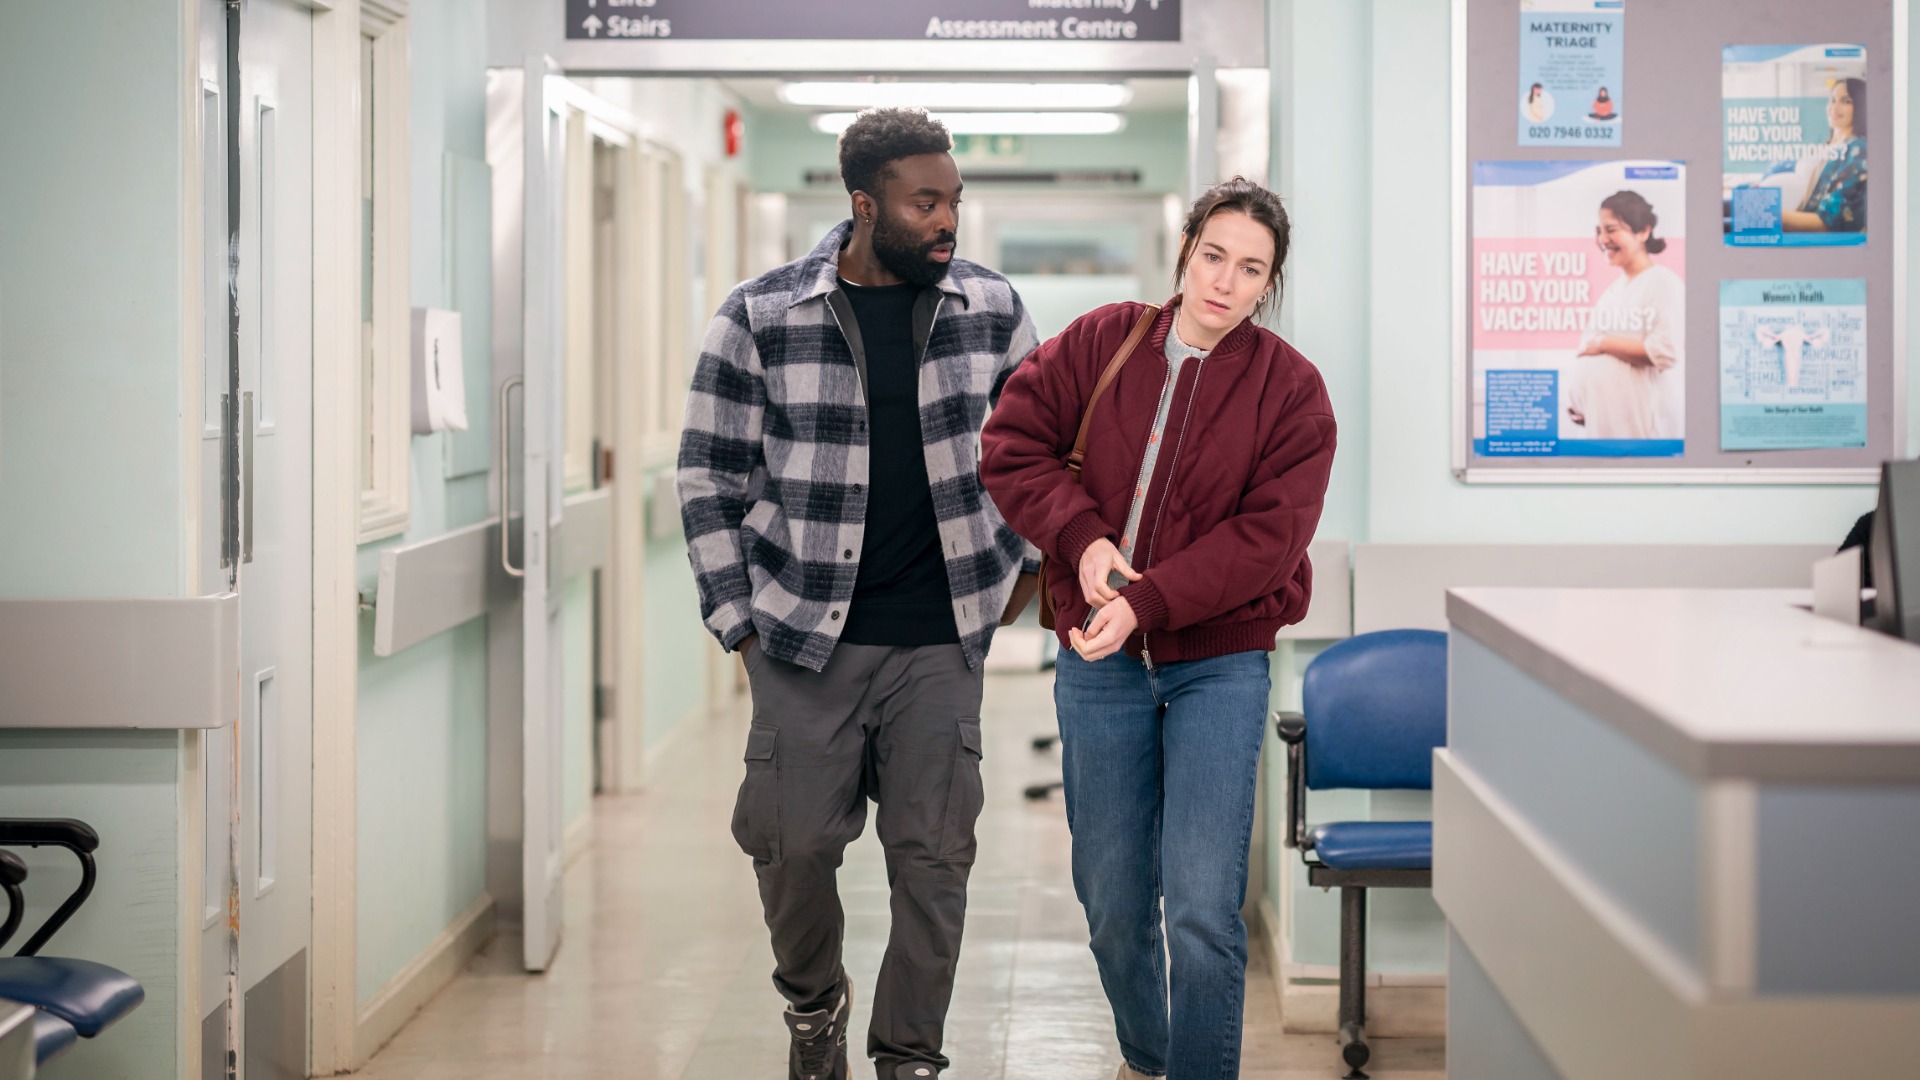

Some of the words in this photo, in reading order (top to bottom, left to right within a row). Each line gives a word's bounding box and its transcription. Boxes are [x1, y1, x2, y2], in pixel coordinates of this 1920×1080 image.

[607, 14, 671, 37] Stairs
[925, 16, 1059, 38] Assessment
[1061, 16, 1138, 38] Centre
[1530, 22, 1613, 34] MATERNITY
[1545, 36, 1598, 49] TRIAGE
[1727, 106, 1767, 124] HAVE
[1769, 106, 1800, 124] YOU
[1528, 125, 1551, 139] 020
[1554, 125, 1582, 139] 7946
[1585, 126, 1613, 139] 0332
[1727, 125, 1758, 142] HAD
[1759, 125, 1803, 142] YOUR
[1727, 143, 1849, 161] VACCINATIONS?
[1481, 252, 1538, 276] HAVE
[1541, 252, 1586, 276] YOU
[1481, 280, 1527, 303] HAD
[1529, 280, 1590, 303] YOUR
[1762, 290, 1797, 303] Women's
[1799, 290, 1825, 302] Health
[1480, 307, 1656, 331] VACCINATIONS?
